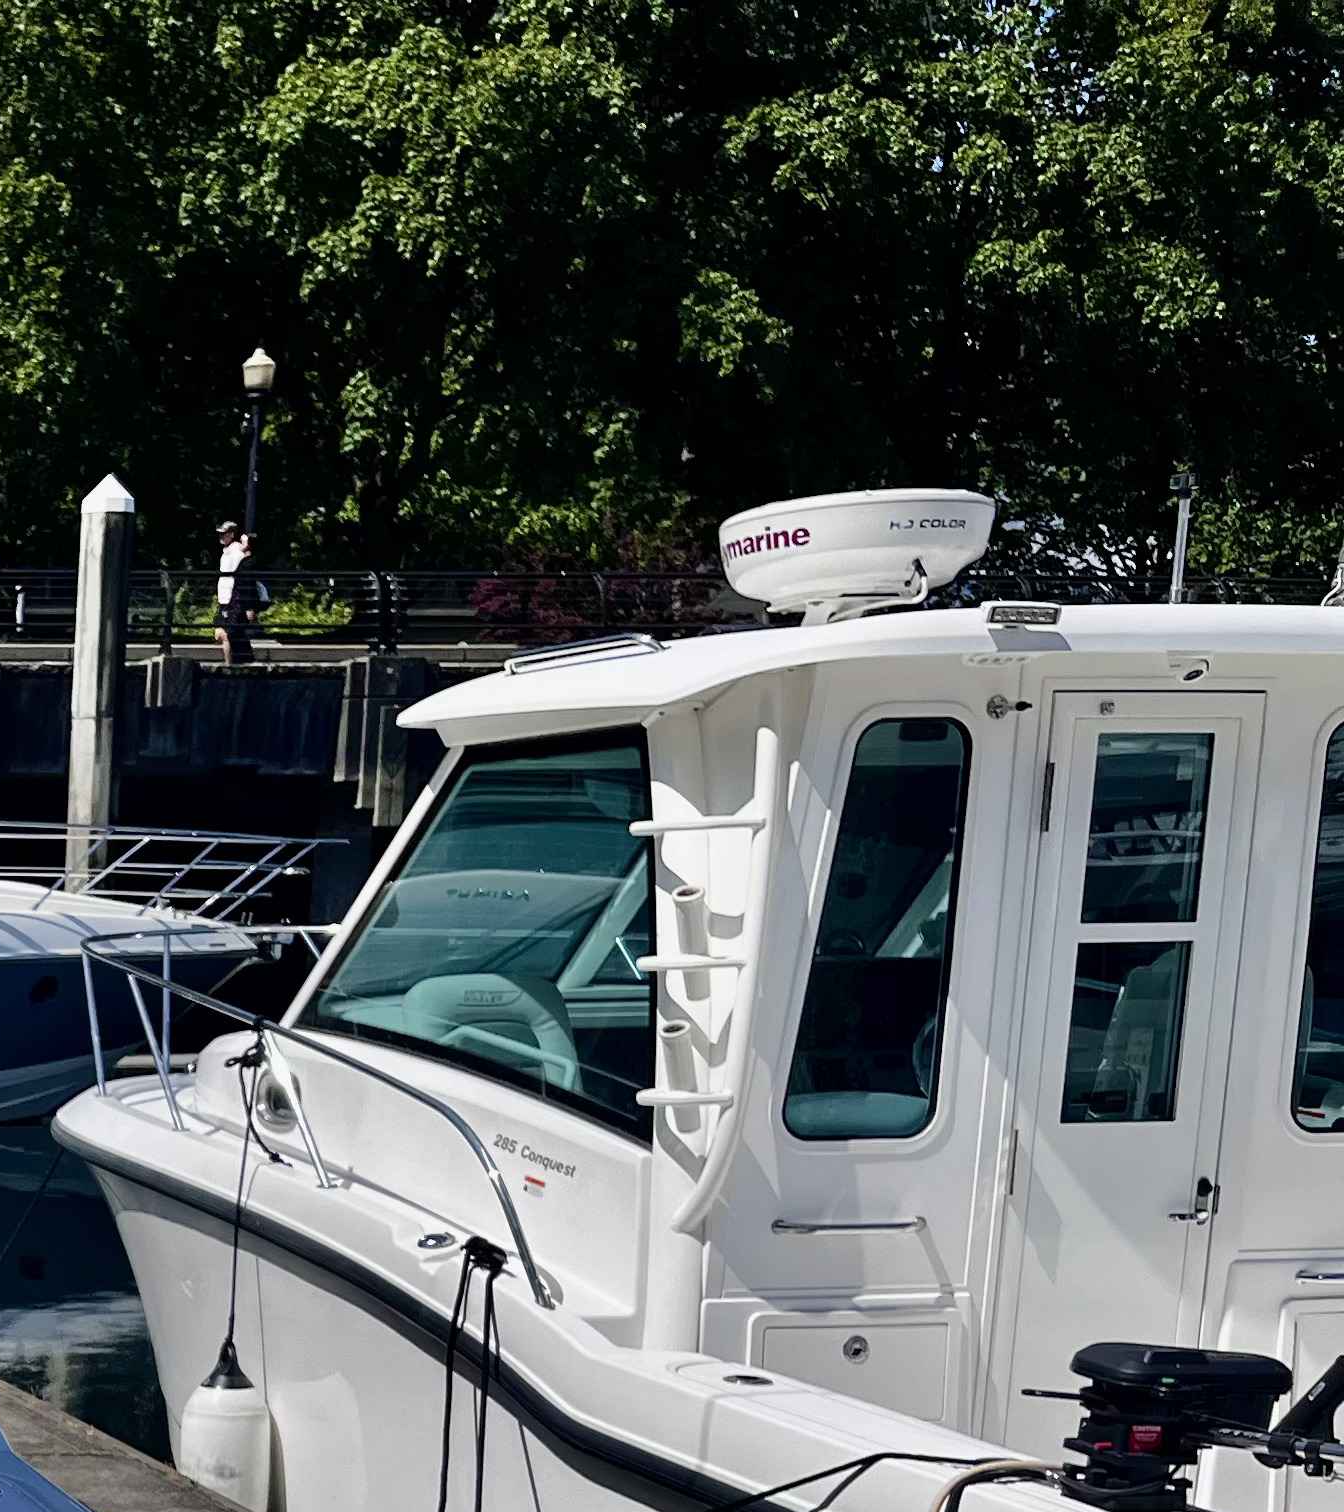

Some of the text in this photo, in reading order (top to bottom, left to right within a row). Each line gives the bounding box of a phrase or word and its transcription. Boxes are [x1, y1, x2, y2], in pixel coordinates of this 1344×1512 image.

[919, 518, 967, 530] COLOR
[493, 1133, 577, 1178] 285 Conquest
